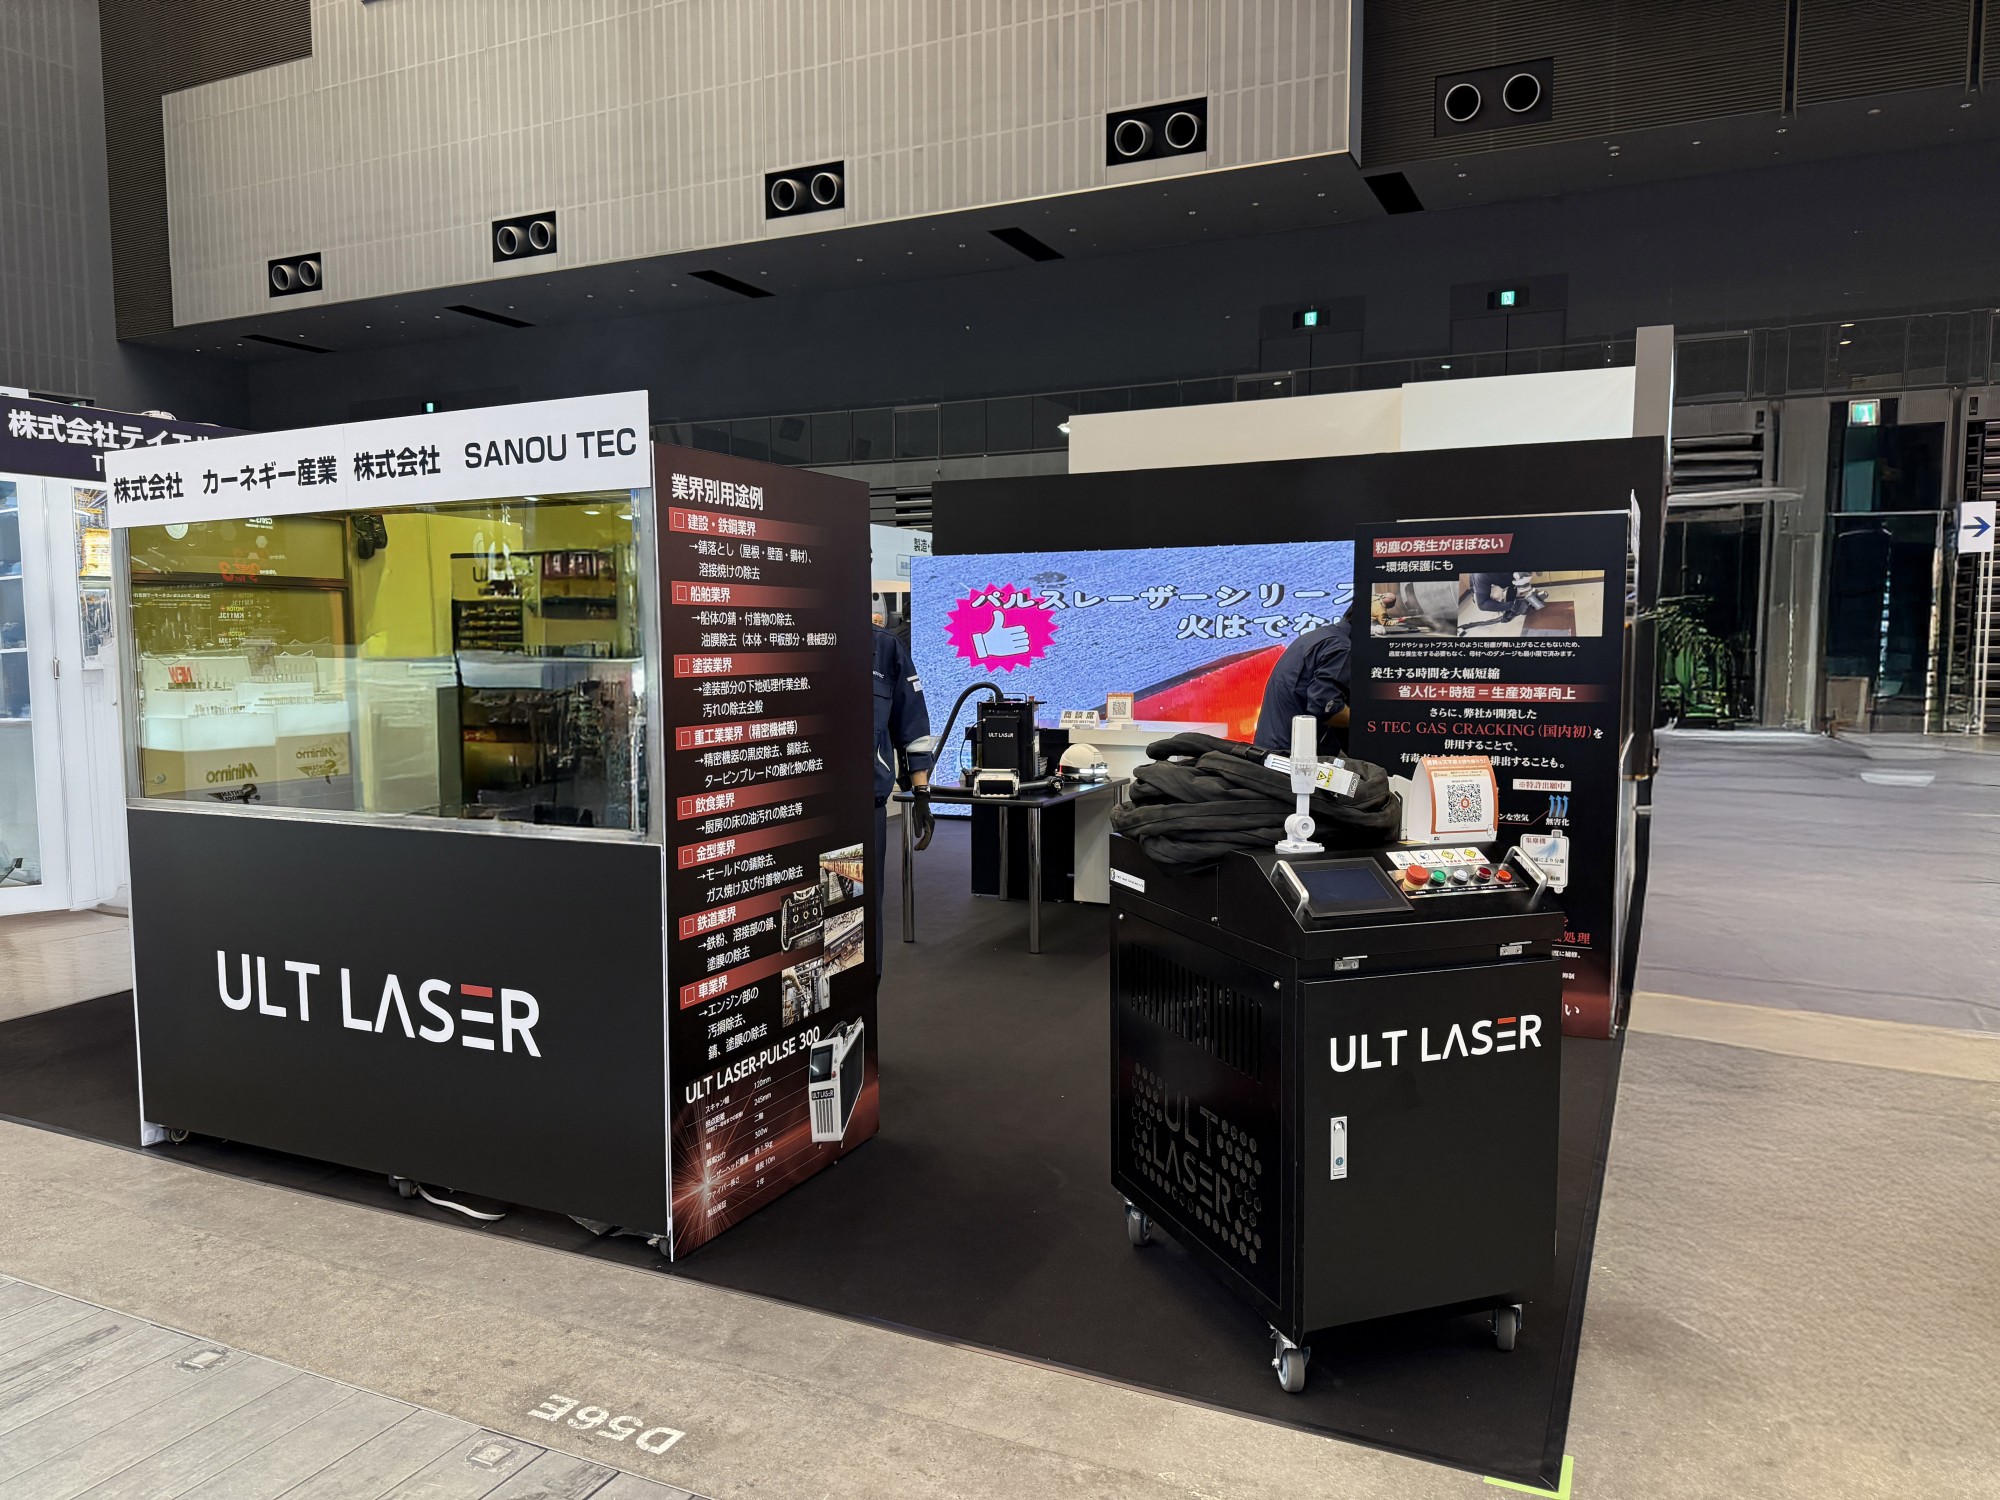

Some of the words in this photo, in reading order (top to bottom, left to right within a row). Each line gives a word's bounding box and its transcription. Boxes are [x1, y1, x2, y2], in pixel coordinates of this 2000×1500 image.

[8, 408, 209, 449] 株式会社テイ
[113, 471, 184, 504] 株式会社
[202, 456, 338, 496] カーネギー産業
[353, 444, 442, 481] 株式会社
[464, 433, 567, 469] SANOU
[576, 427, 637, 459] TEC
[671, 473, 764, 511] 業界別用途例
[688, 513, 756, 536] 建設・鉄鋼業界
[1375, 537, 1504, 555] 粉塵の発生がほぼない
[698, 562, 760, 580] 溶接焼けの除去
[1385, 559, 1454, 573] 環境保護にも
[690, 586, 731, 604] 船舶業界
[1176, 611, 1341, 640] 火はでな
[692, 657, 733, 674] 塗装業界
[1371, 667, 1501, 681] 養生する時間を大幅短縮
[703, 700, 764, 718] 汚れの除去全般
[1367, 720, 1376, 733] S
[1381, 720, 1411, 734] TEC
[1416, 721, 1447, 735] GAS
[1452, 722, 1535, 737] CRACKING
[695, 793, 735, 813] 飲食業界
[1498, 813, 1529, 822] ンな空気
[696, 839, 736, 862] 金型業界
[697, 906, 737, 932] 鉄道業界
[1552, 930, 1591, 945] 処理
[706, 945, 750, 972] 塗膜の除去
[698, 976, 728, 999] 車業界
[217, 950, 320, 1022] ULT
[340, 967, 542, 1058] LASER
[1329, 1030, 1408, 1073] ULT
[1421, 1014, 1542, 1063] LASER
[685, 1080, 713, 1104] ULT
[716, 1038, 796, 1090] LASER-PULSE
[799, 1025, 821, 1050] 300
[1164, 1082, 1219, 1157] ULT
[1153, 1126, 1231, 1223] LASER
[526, 1393, 686, 1455] D56E
